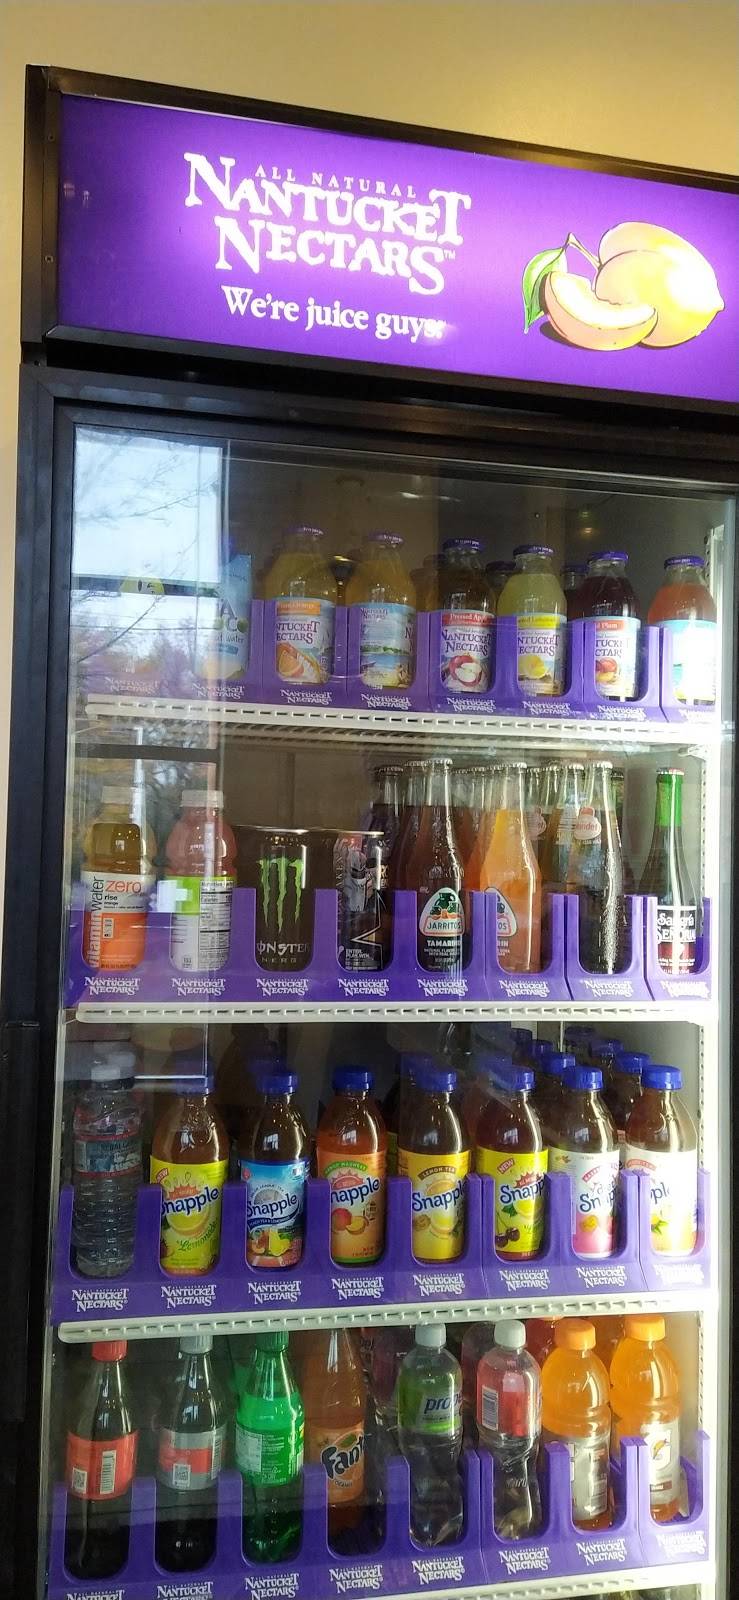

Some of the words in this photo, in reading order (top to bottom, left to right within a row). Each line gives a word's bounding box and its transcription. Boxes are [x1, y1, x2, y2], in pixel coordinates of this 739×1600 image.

[255, 164, 296, 182] ALL
[311, 172, 417, 198] NATURAL
[183, 152, 472, 246] NANTUCKET
[214, 215, 445, 296] NECTARS
[221, 285, 300, 322] We're
[305, 297, 369, 331] juice
[446, 641, 489, 657] NECTARS
[105, 880, 142, 894] zero
[104, 893, 118, 901] rise
[427, 921, 462, 931] JARRITOS
[422, 1167, 443, 1177] LEMON
[412, 1180, 465, 1212] Snappl
[247, 1193, 297, 1217] Snapple
[161, 1284, 217, 1297] NANTUCKET
[248, 1280, 301, 1294] NANTUCKET
[167, 1296, 212, 1309] NECTARS
[254, 1292, 298, 1305] NECTARS
[576, 1538, 626, 1554] NANTUCKET
[500, 1547, 550, 1564] NANTUCKET
[584, 1549, 626, 1567] NECTARS
[329, 1564, 382, 1582] NANTUCKET
[412, 1556, 464, 1573] NANTUCKET
[506, 1559, 549, 1576] NECTARS
[245, 1573, 299, 1590] NANTUCKET
[336, 1578, 381, 1593] NECTARS
[419, 1569, 463, 1586] NECTARS
[157, 1581, 213, 1598] NANTUCKET
[251, 1586, 297, 1600] NECTARS
